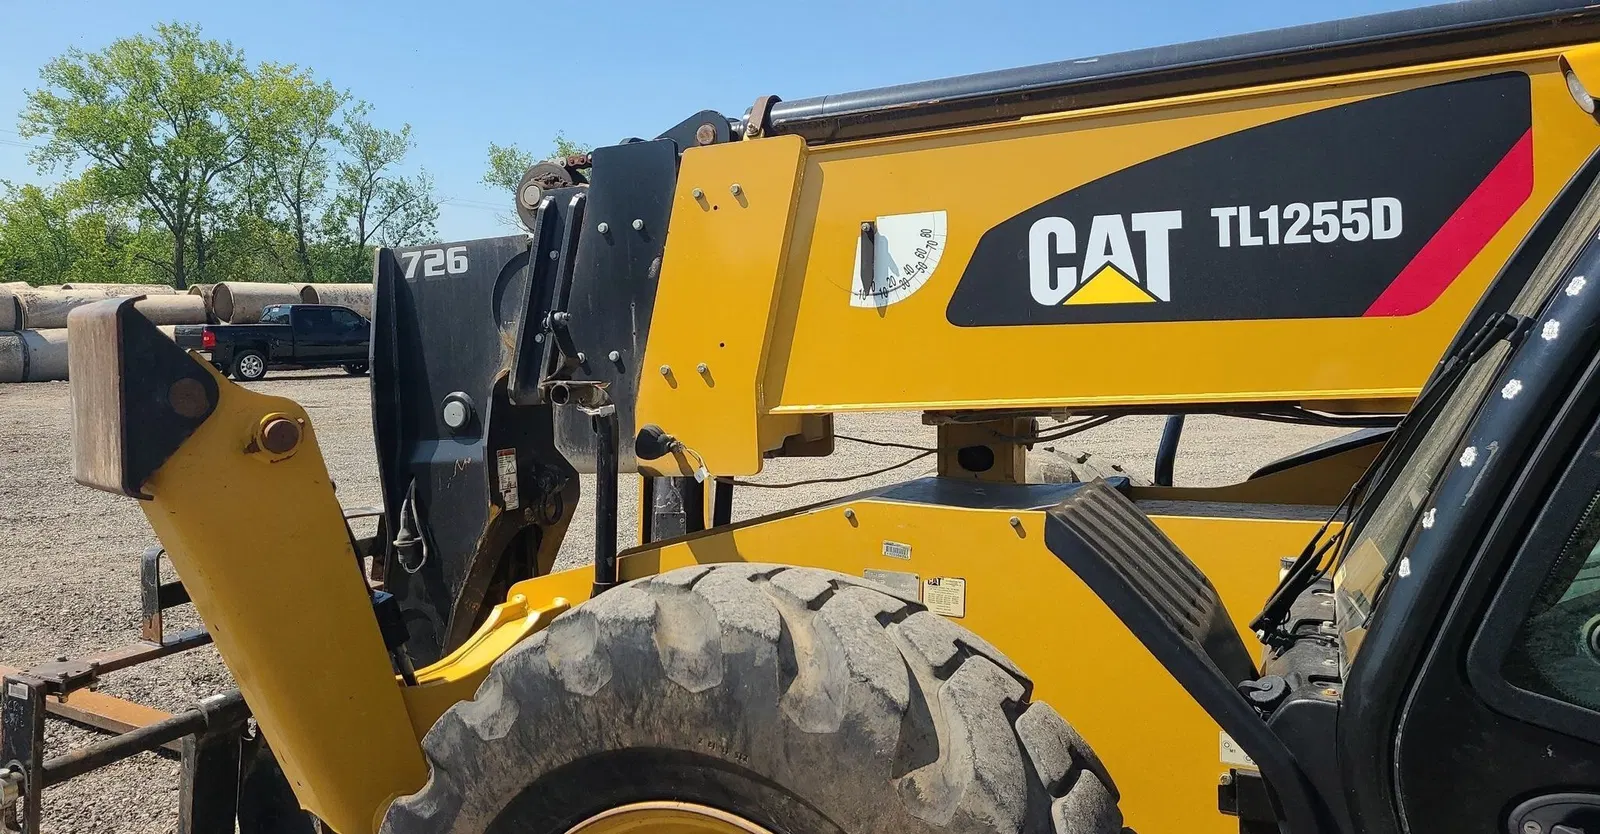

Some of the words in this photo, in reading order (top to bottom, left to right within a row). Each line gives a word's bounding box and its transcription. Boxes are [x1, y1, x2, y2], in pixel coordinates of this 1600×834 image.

[920, 228, 932, 239] 80
[925, 239, 939, 251] 70
[1028, 210, 1183, 306] CAT
[1210, 196, 1403, 248] TL1255D
[914, 247, 927, 259] 60
[401, 246, 468, 279] 726
[915, 261, 928, 274] 50
[903, 263, 915, 276] 40
[886, 275, 897, 288] 20
[899, 277, 911, 290] 30
[879, 286, 888, 300] 10
